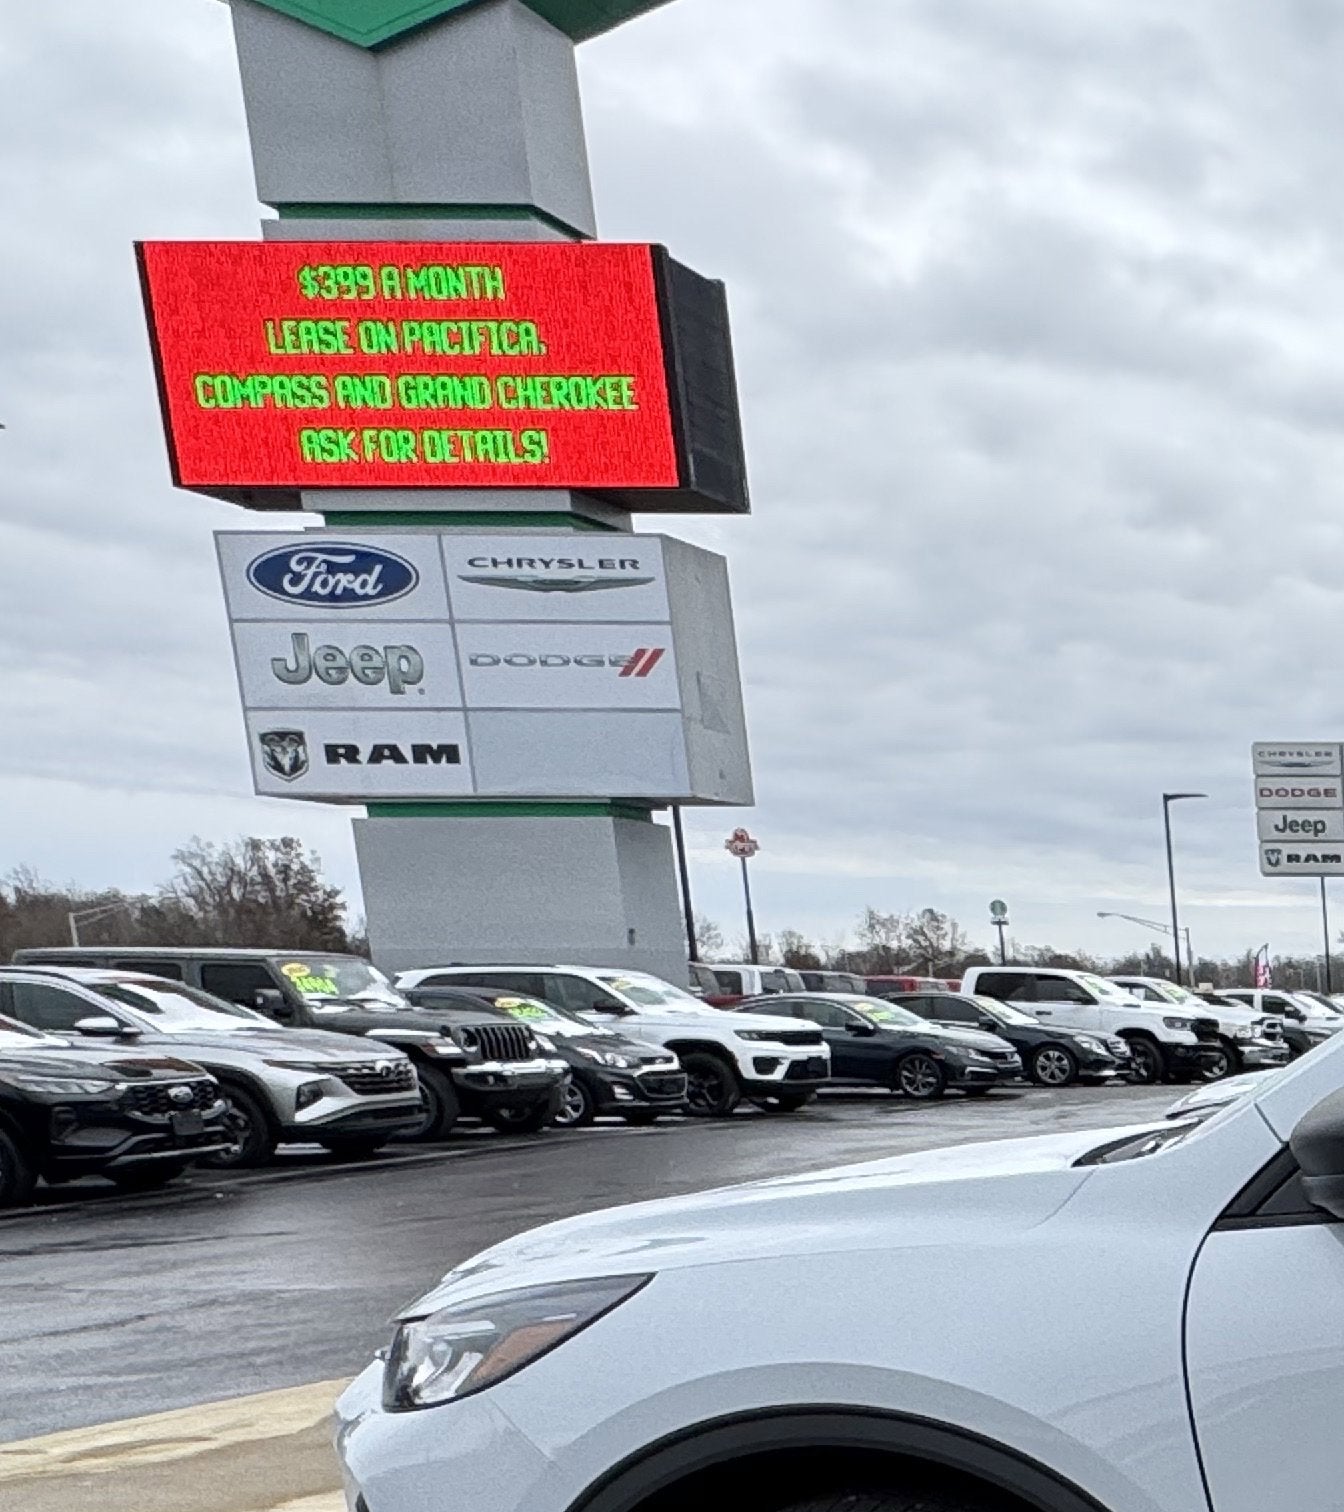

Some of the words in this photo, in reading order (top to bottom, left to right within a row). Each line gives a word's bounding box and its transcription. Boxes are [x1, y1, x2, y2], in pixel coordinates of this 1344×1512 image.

[298, 265, 376, 300] $399
[380, 265, 402, 300] A
[405, 265, 505, 301] MONTH
[265, 319, 354, 355] LEASE
[358, 319, 398, 355] ON
[195, 373, 330, 409] COMPASS
[334, 373, 393, 409] AND
[396, 373, 492, 410] GRAND
[496, 374, 638, 410] CHEROKEE
[300, 428, 359, 463] ASK
[362, 428, 418, 463] FOR
[421, 428, 550, 464] DETAILS!
[282, 551, 384, 597] Ford
[466, 556, 641, 570] CHRYSLER
[270, 632, 425, 695] Jeep
[468, 653, 634, 669] DODGE
[324, 743, 461, 765] RAM
[1256, 750, 1334, 758] CHRYSLER
[1259, 787, 1338, 798] DODGE
[1274, 814, 1326, 838] Jeep
[1286, 853, 1342, 864] RAM
